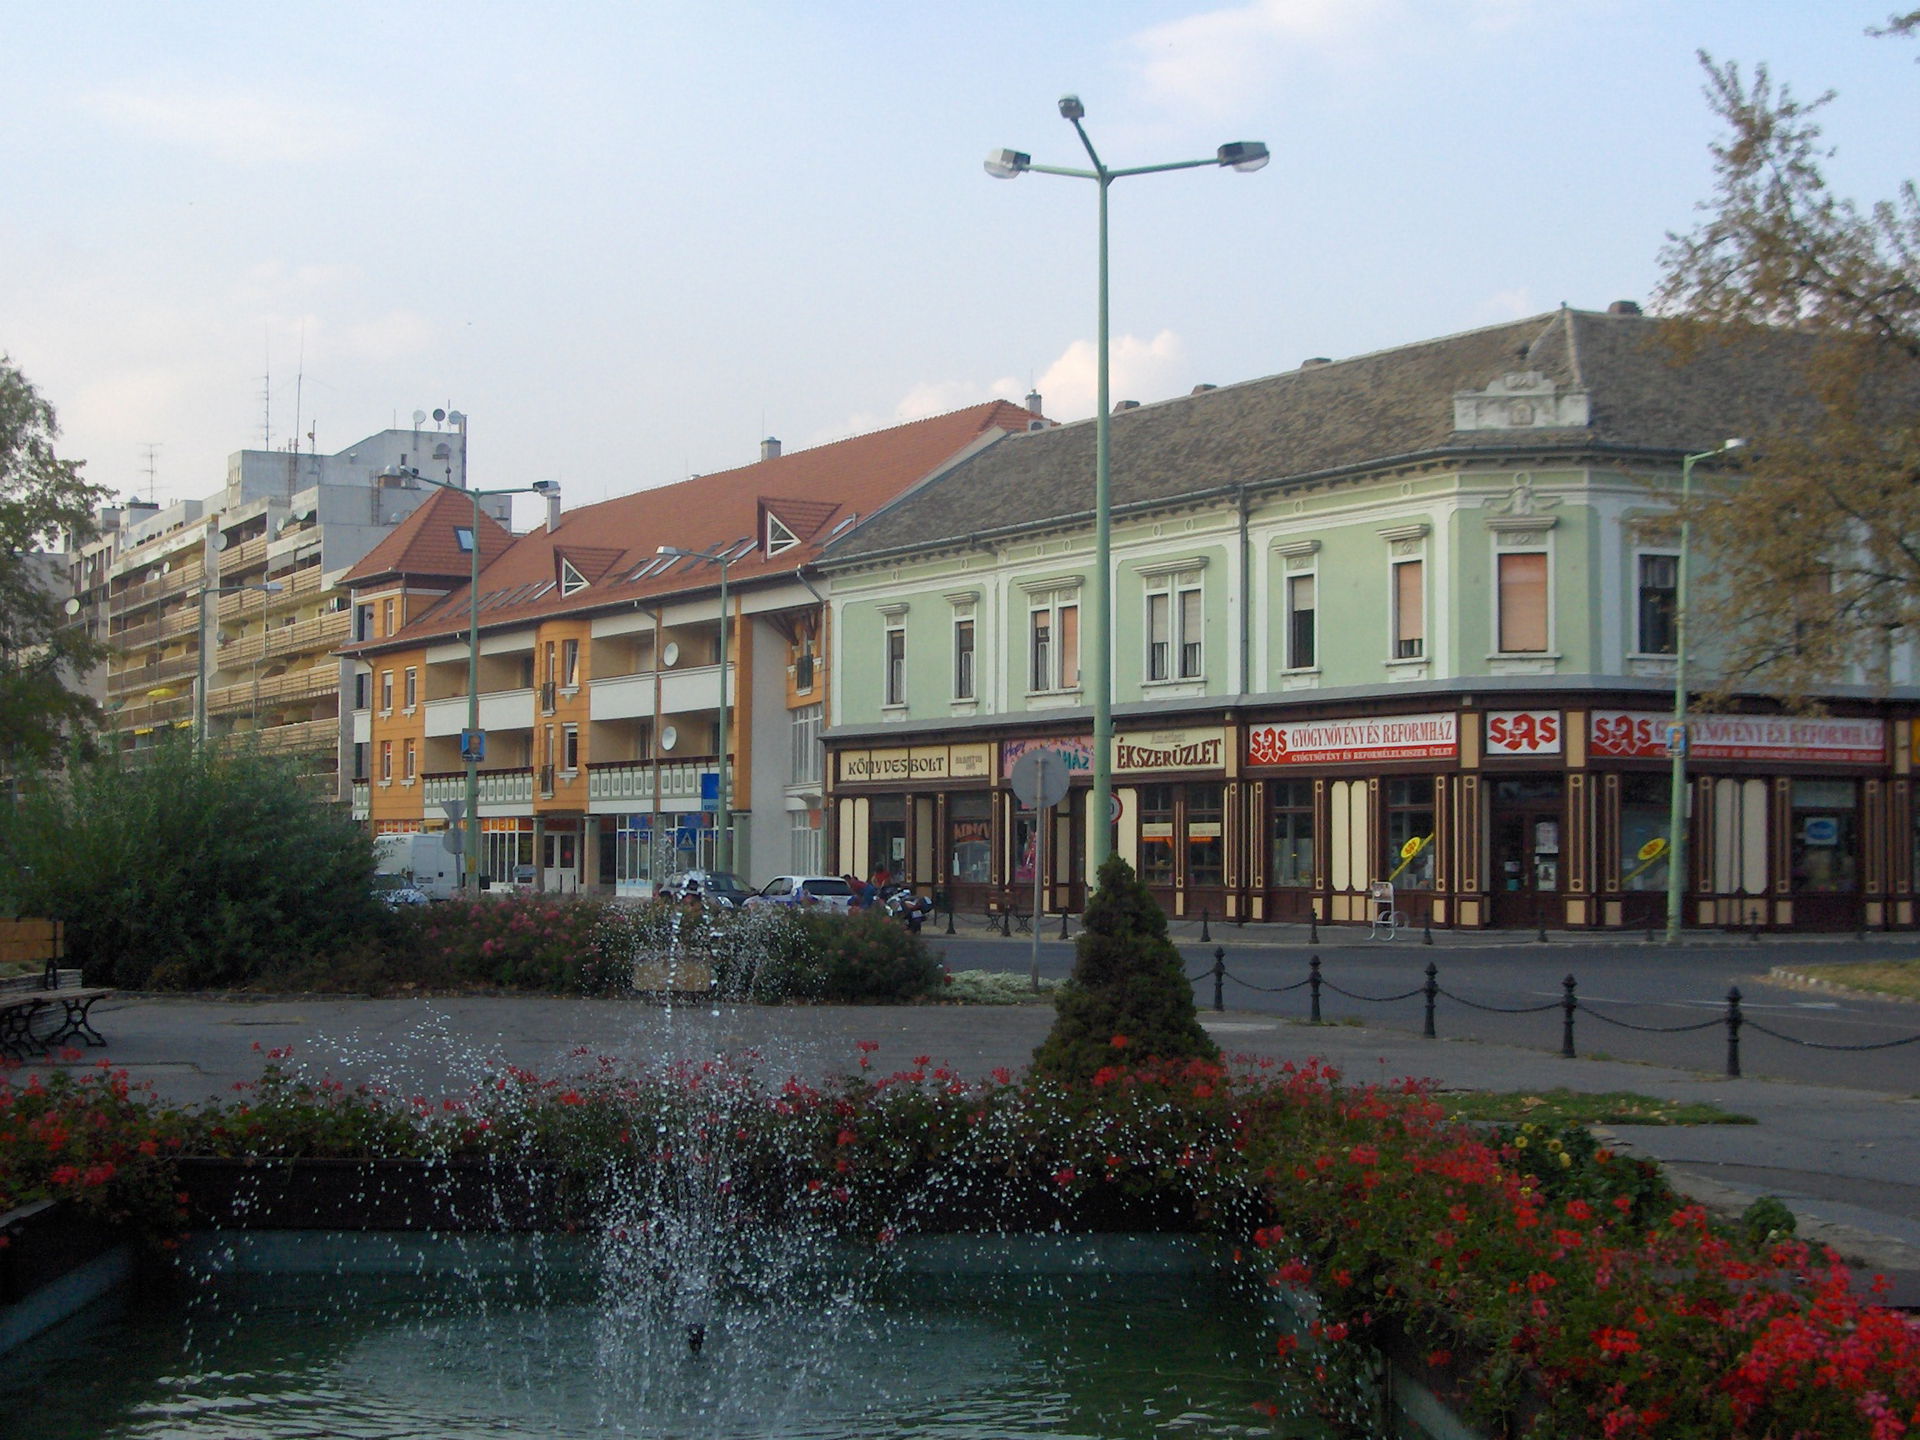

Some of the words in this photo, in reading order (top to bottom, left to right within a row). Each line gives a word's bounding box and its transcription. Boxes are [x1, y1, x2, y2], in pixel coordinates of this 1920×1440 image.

[1251, 727, 1288, 762] SAS
[1292, 721, 1365, 748] GYÓGYNÖVÉNY
[1367, 720, 1380, 744] ÉS
[1383, 715, 1452, 743] REFORMHÁZ
[1489, 713, 1557, 751] SAS
[1594, 715, 1651, 753] SAS
[1117, 737, 1221, 769] ÉKSZERÜZLET
